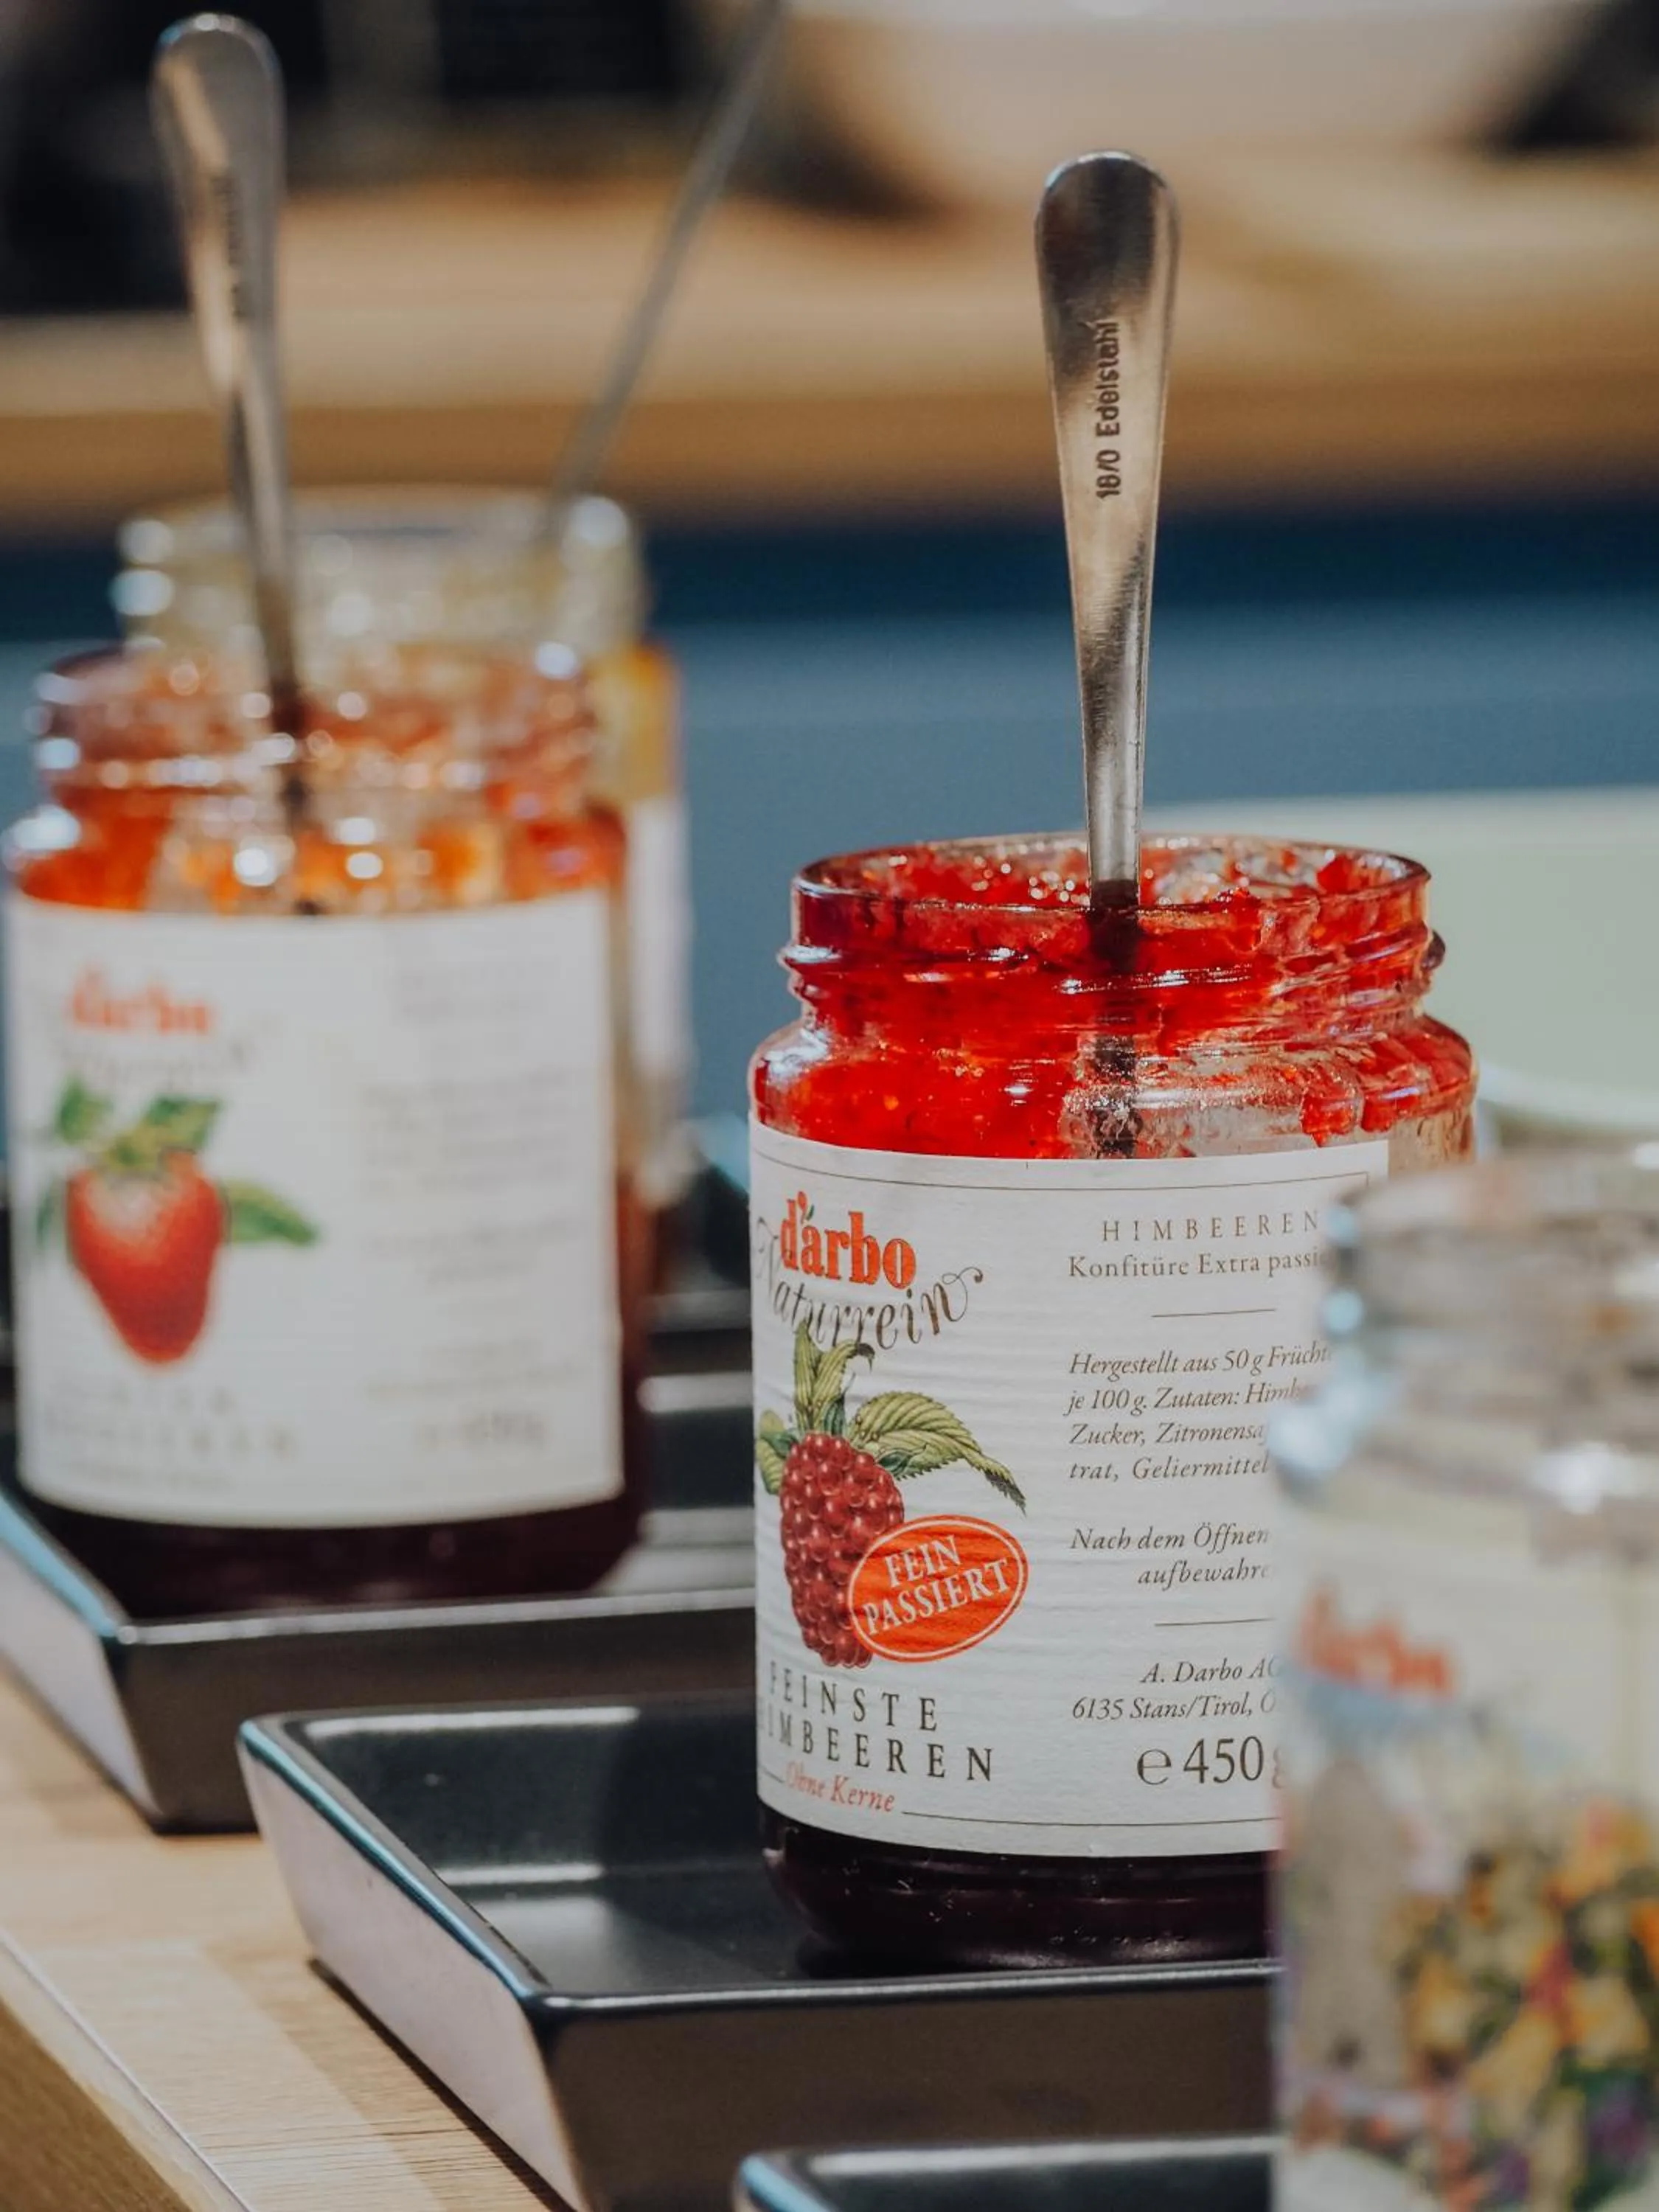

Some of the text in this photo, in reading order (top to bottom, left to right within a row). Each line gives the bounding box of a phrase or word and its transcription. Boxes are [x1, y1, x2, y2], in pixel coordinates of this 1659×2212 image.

[1095, 320, 1121, 499] 18/0 Edelstahl
[1102, 1209, 1318, 1242] HIMBEEREN
[1069, 1254, 1189, 1278] Konfitüre
[1198, 1253, 1260, 1274] Extra
[757, 1217, 984, 1350] Naturrein
[1070, 1349, 1178, 1382] Hergestellt
[1183, 1357, 1219, 1374] aus
[1062, 1390, 1085, 1416] je
[1154, 1386, 1239, 1409] Zutaten:
[1069, 1422, 1146, 1447] Zucker,
[1070, 1449, 1270, 1483] trat, Geliermittel
[1071, 1522, 1269, 1555] Nach dem Öffnen
[884, 1534, 963, 1588] FEIN
[863, 1559, 1011, 1637] PASSIERT
[1139, 1663, 1166, 1683] A.
[1172, 1658, 1242, 1683] Darbo
[770, 1660, 937, 1732] FEINSTE
[1072, 1696, 1124, 1719] 6135
[1130, 1691, 1253, 1720] Stans/Tirol,
[758, 1697, 994, 1782] IMBEEREN
[785, 1760, 895, 1812] Ohne Kerne
